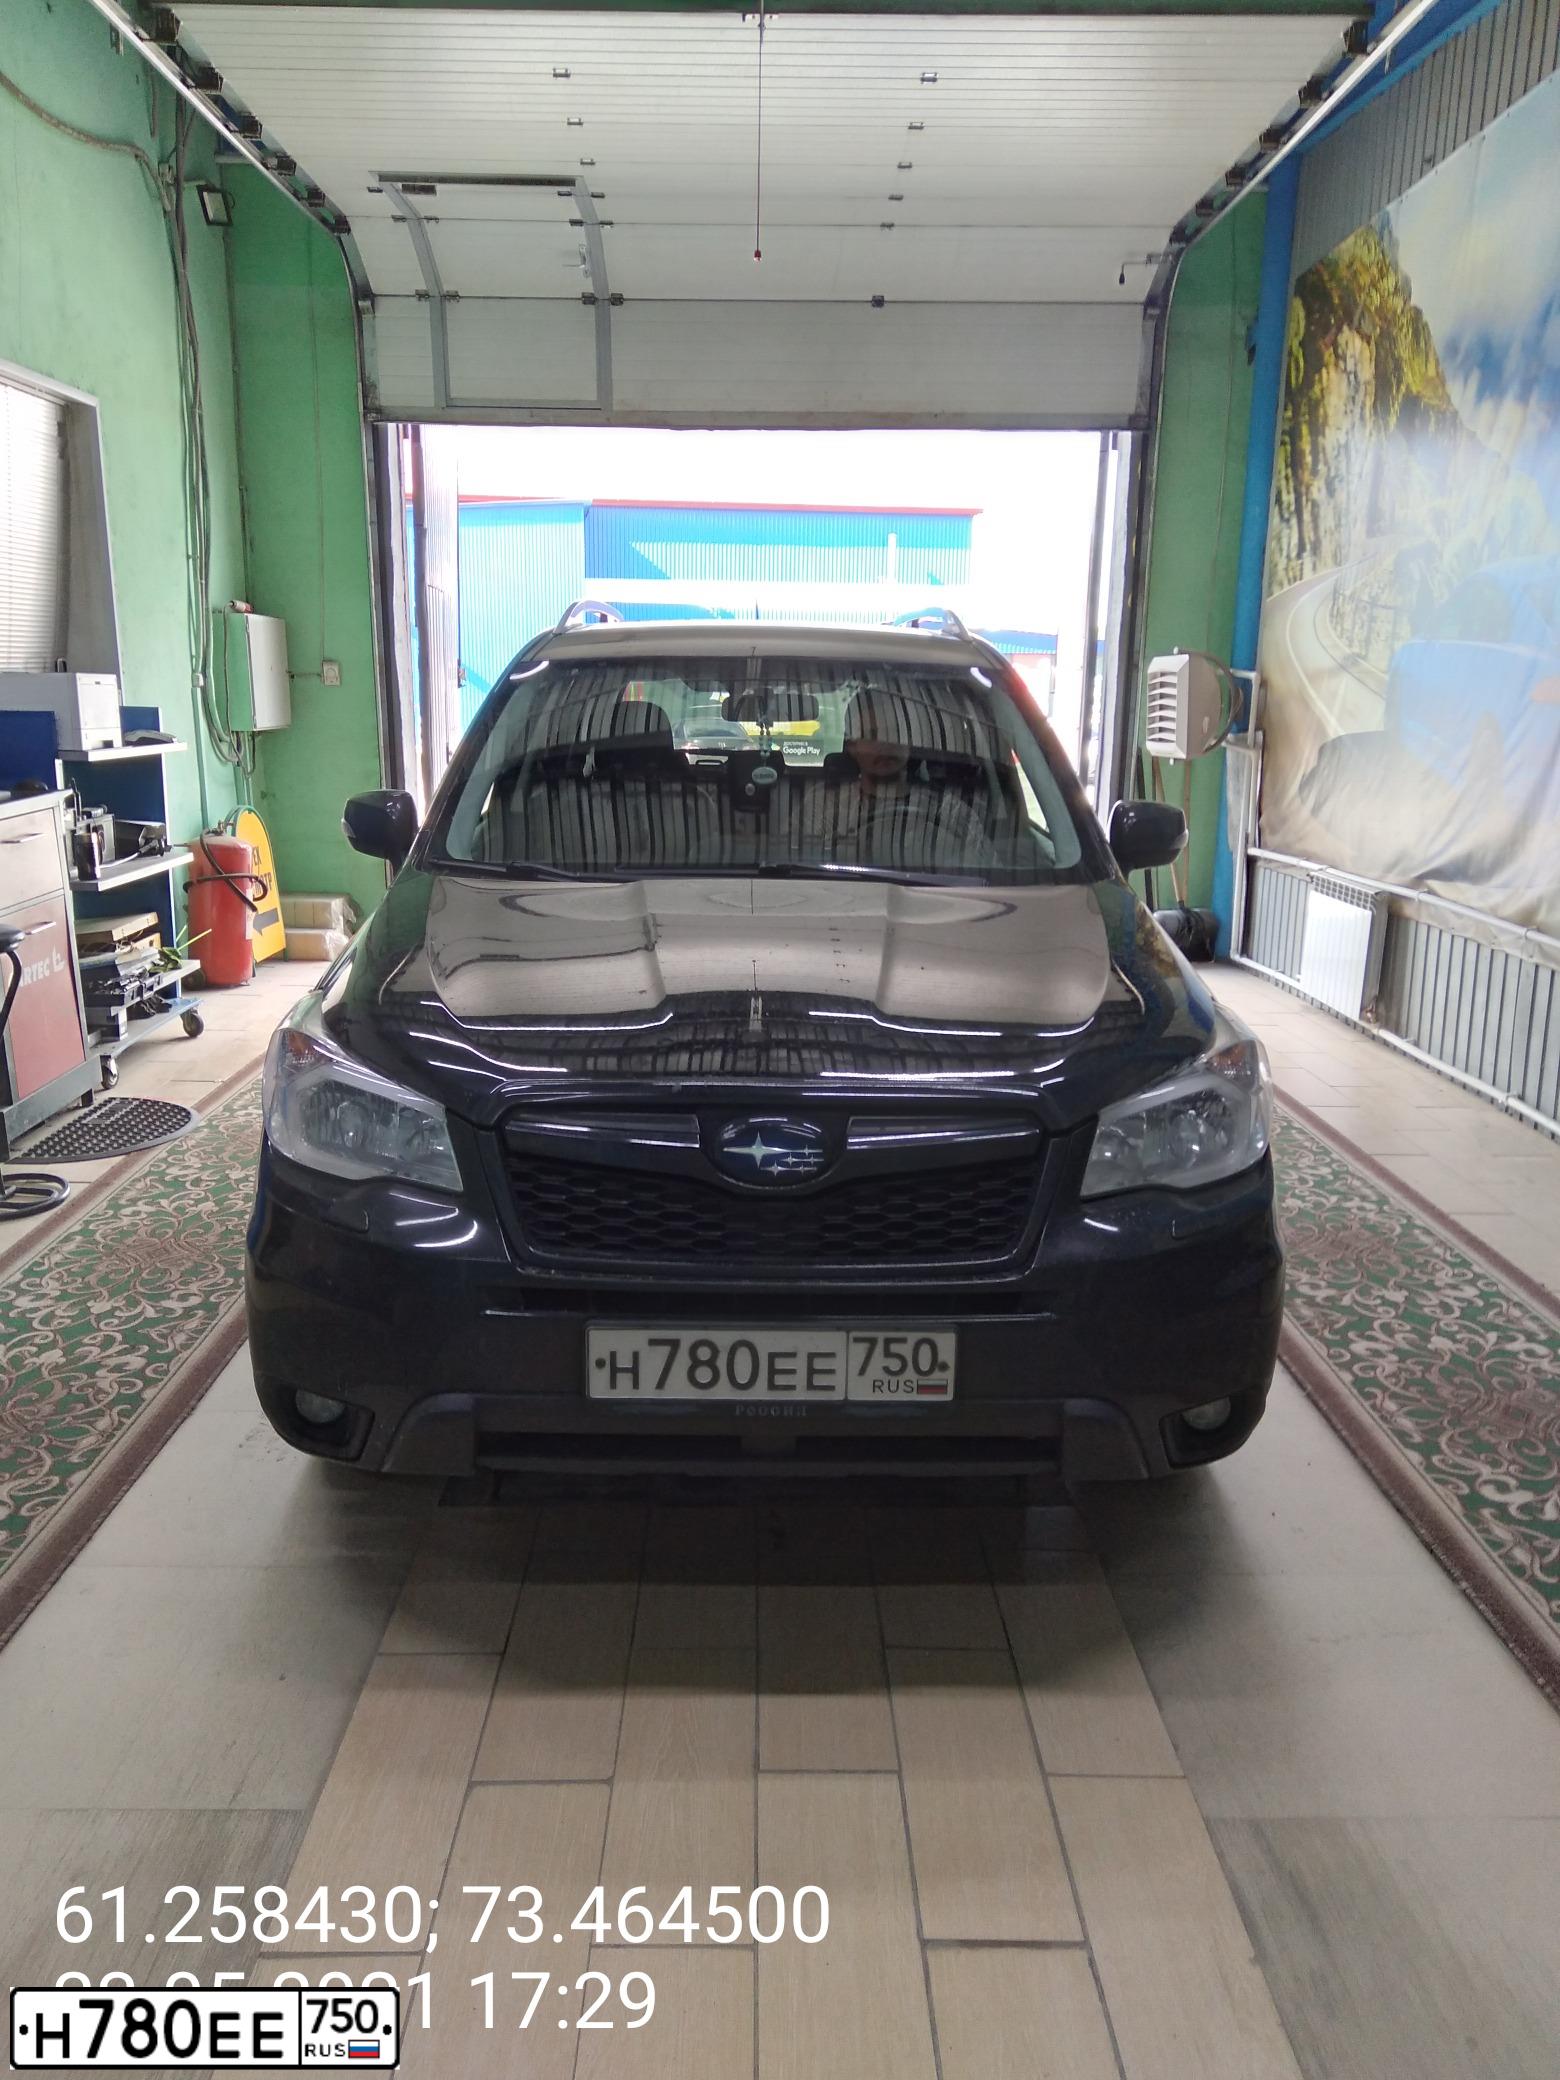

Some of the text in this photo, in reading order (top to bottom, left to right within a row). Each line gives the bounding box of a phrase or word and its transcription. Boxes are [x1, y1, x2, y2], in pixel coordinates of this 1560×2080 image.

[782, 746, 820, 756] Google Play
[609, 1337, 939, 1392] Н780ЕЕ 750
[872, 1380, 914, 1394] RUS
